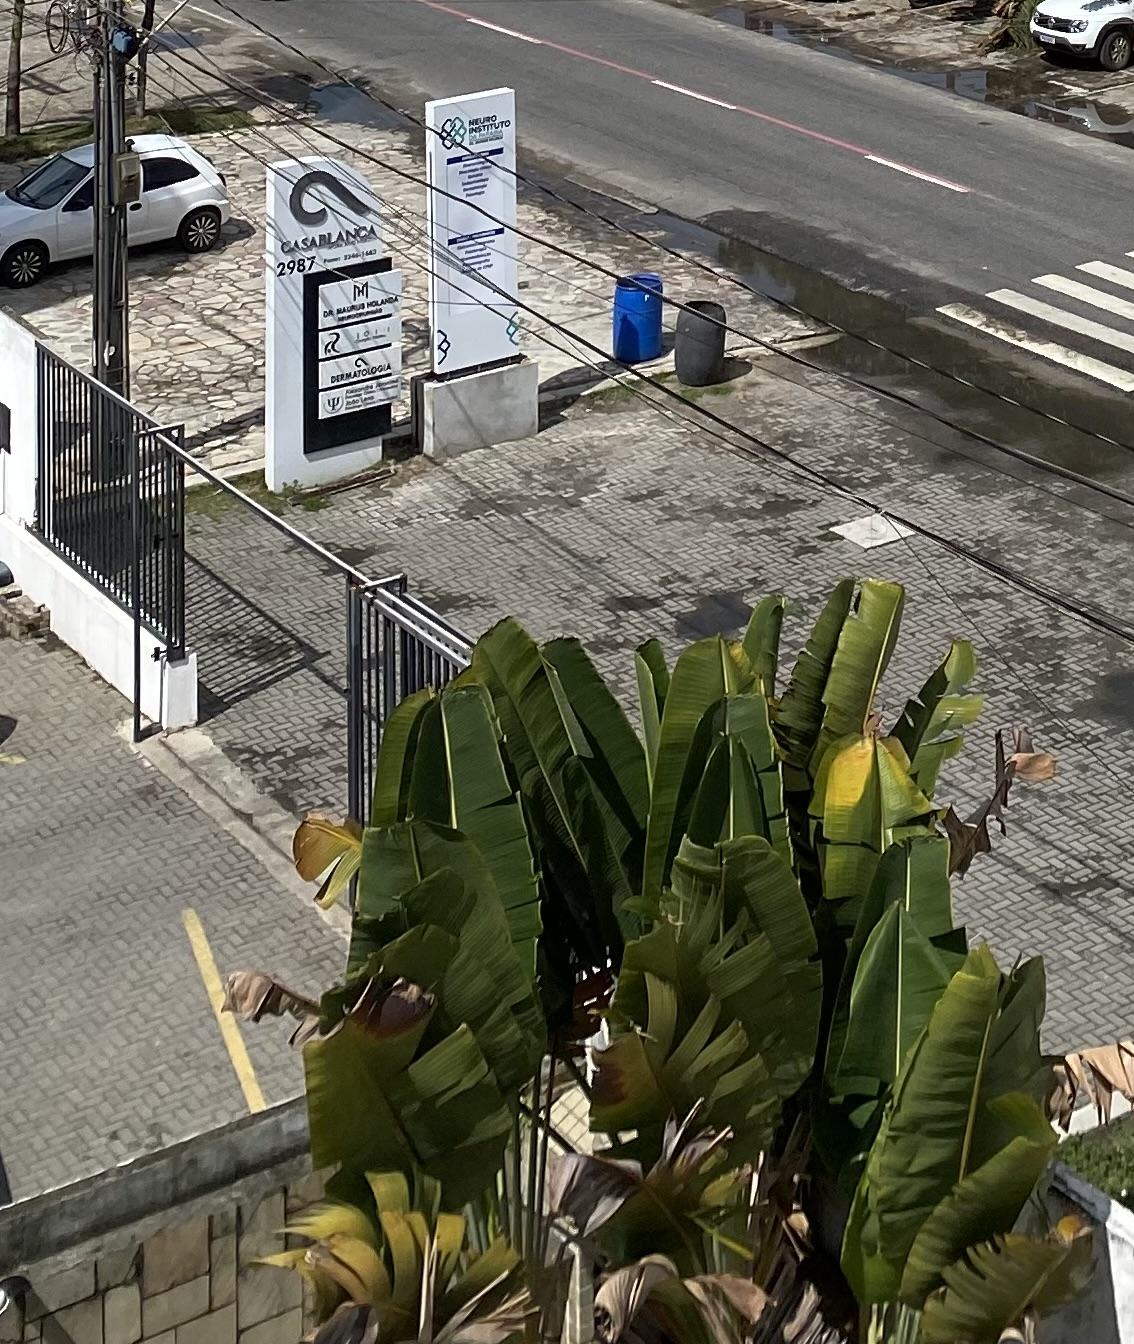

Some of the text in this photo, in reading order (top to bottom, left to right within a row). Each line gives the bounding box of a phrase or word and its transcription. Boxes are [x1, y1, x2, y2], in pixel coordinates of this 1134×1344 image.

[468, 114, 497, 127] NEURO
[468, 119, 512, 135] INSTITUTO
[280, 224, 379, 255] CASABLANCA
[276, 255, 317, 278] 2987
[366, 296, 399, 309] HOLANDA
[330, 363, 392, 384] DERMATOLOGIA
